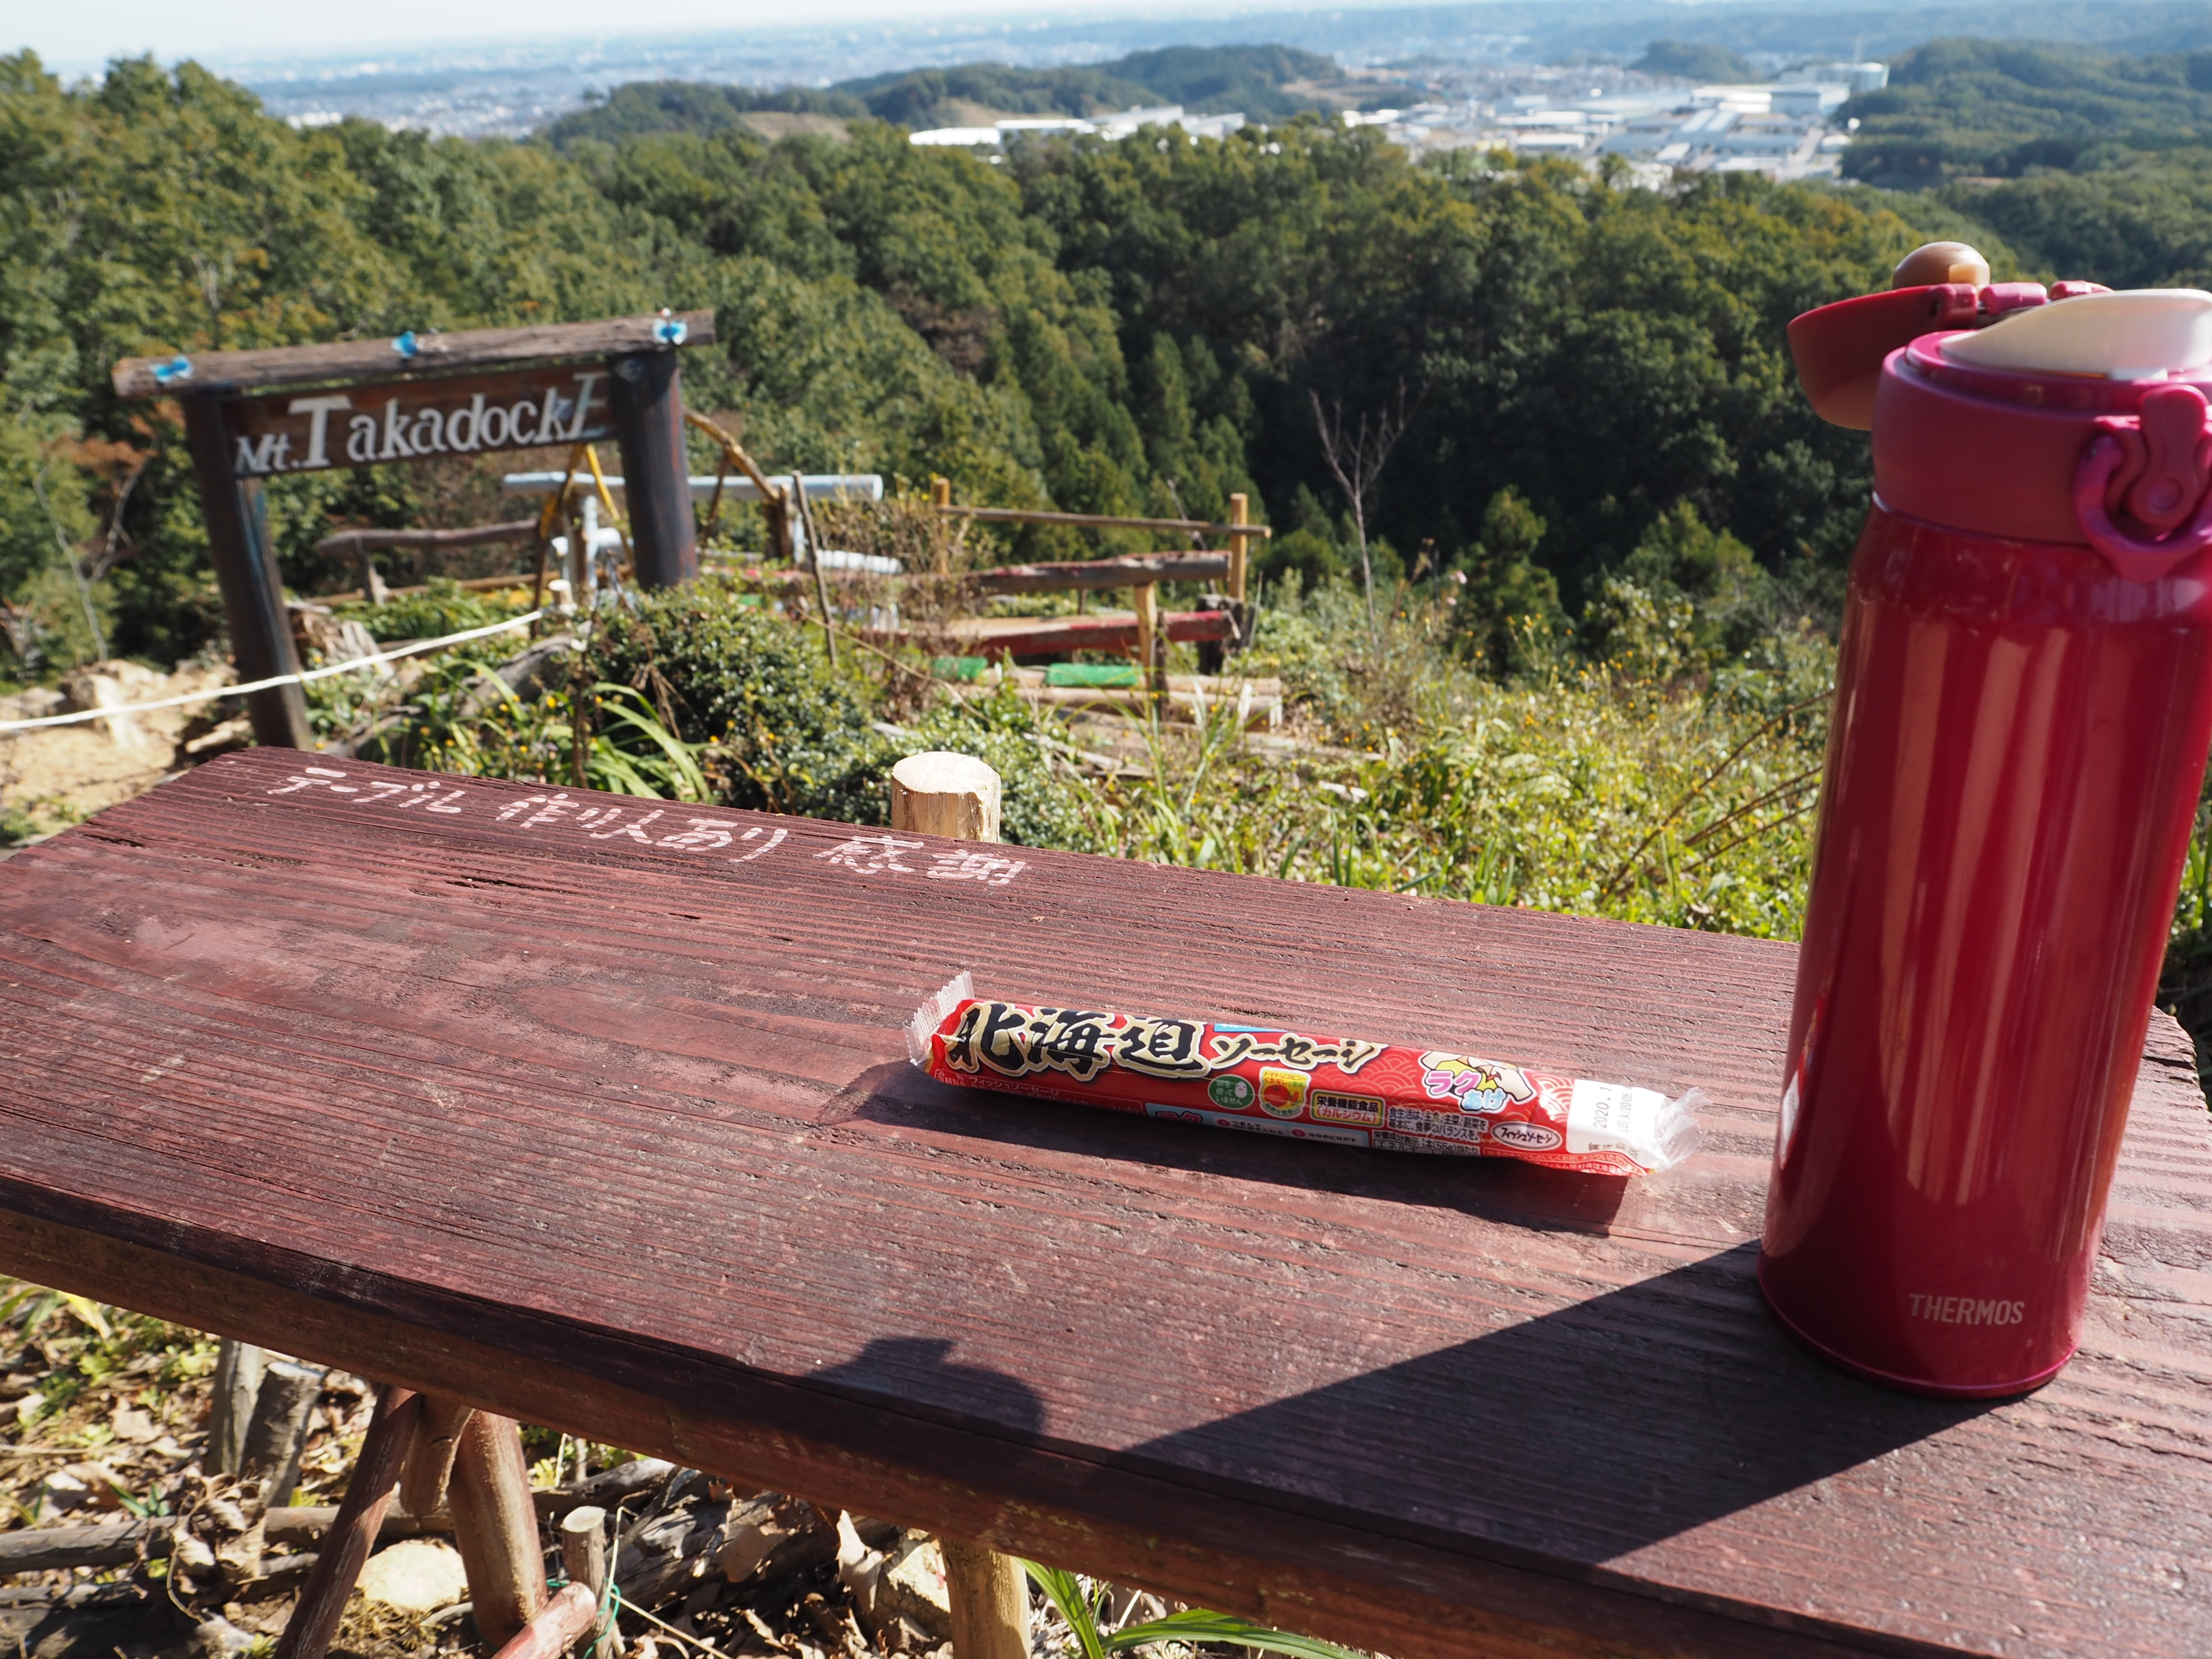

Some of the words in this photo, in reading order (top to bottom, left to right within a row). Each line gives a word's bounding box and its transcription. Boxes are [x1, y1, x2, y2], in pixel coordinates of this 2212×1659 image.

[234, 433, 299, 473] Mt.
[266, 767, 466, 814] テーブル
[813, 835, 1026, 886] 感謝
[947, 1002, 1207, 1078] 北海道
[1213, 1035, 1380, 1070] ソーセージ
[1425, 1070, 1482, 1096] ラク
[1317, 1095, 1379, 1113] 栄養機能食品
[1910, 1294, 2025, 1326] THERMOS
